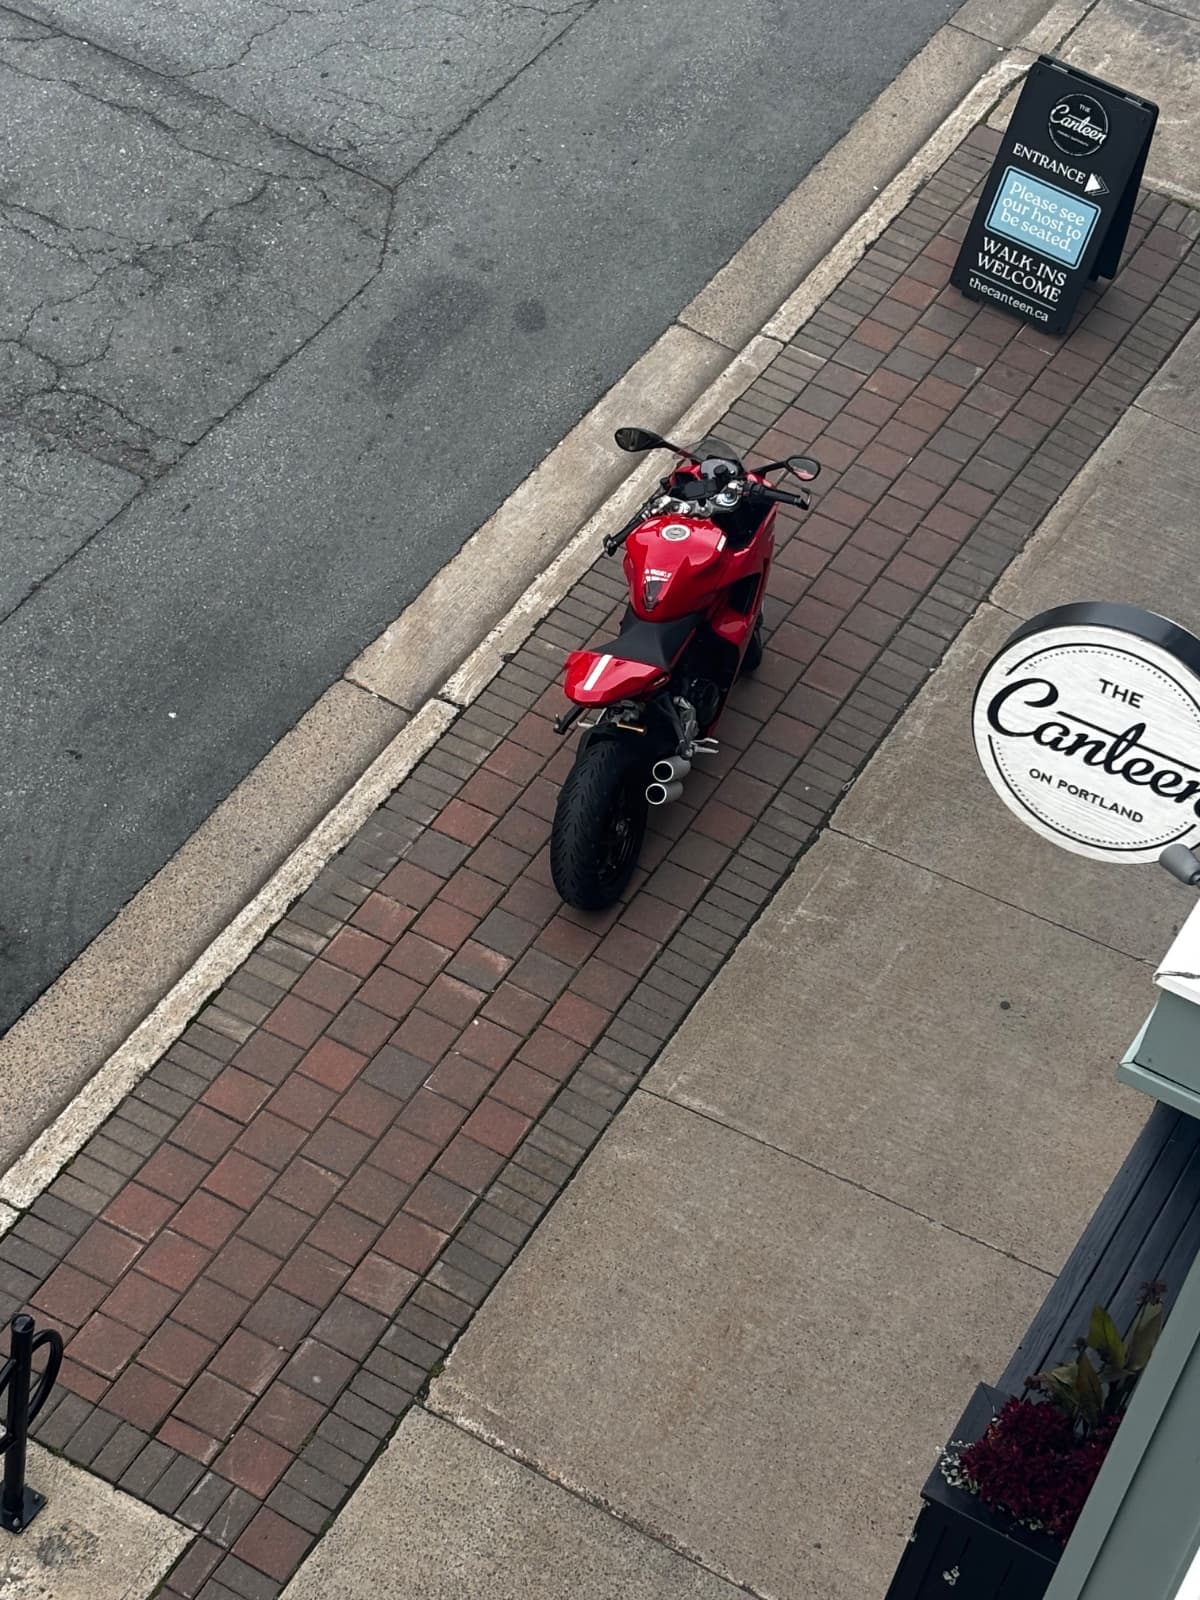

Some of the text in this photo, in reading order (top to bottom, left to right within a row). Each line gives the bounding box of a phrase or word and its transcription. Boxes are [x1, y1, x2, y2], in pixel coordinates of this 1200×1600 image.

[1050, 103, 1107, 145] Canteen
[1012, 142, 1086, 185] ENTRANCE
[1002, 197, 1082, 241] our host to
[1009, 182, 1085, 227] Please see
[1000, 209, 1071, 252] be seated.
[978, 253, 1062, 302] WELCOME
[983, 237, 1067, 286] WALK-INS
[969, 277, 1049, 322] thecanteen.ca
[1099, 678, 1144, 709] THE
[1029, 768, 1144, 823] ON PORTLAND
